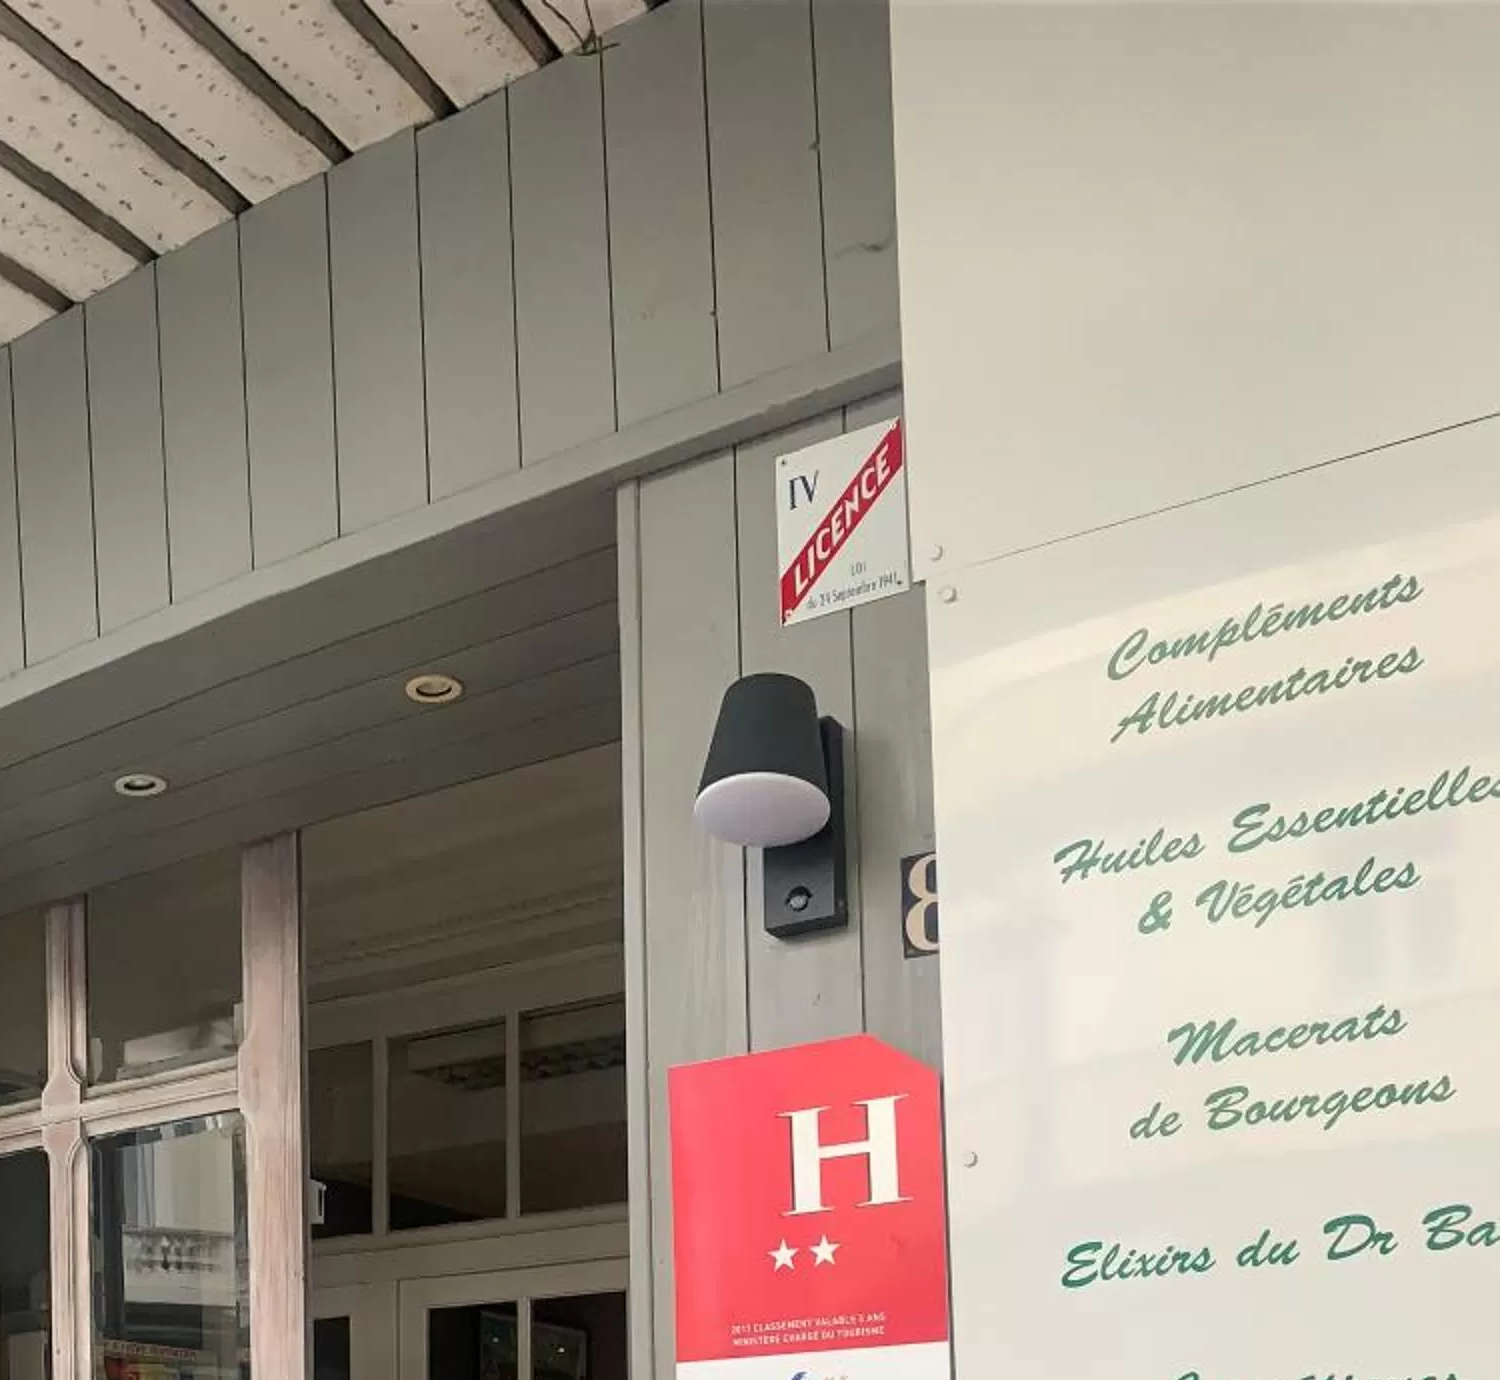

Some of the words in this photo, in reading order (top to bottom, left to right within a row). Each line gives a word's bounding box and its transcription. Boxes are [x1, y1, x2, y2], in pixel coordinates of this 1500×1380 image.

[789, 470, 820, 510] IV
[793, 443, 891, 597] LICENCE
[1108, 574, 1424, 680] Compléments
[1110, 646, 1425, 742] Alimentaires
[1054, 828, 1206, 883] Huiles
[1138, 891, 1172, 934] &
[1195, 856, 1421, 928] Végétales
[1167, 1005, 1408, 1066] Macerats
[1130, 1102, 1183, 1139] de
[1204, 1075, 1457, 1130] Bourgeons
[775, 1093, 914, 1217] H
[1062, 1241, 1216, 1288] Elixirs
[1237, 1229, 1300, 1267] du
[1323, 1214, 1399, 1261] Dr
[753, 1319, 812, 1333] CLASSEMENT
[821, 1329, 834, 1340] DU
